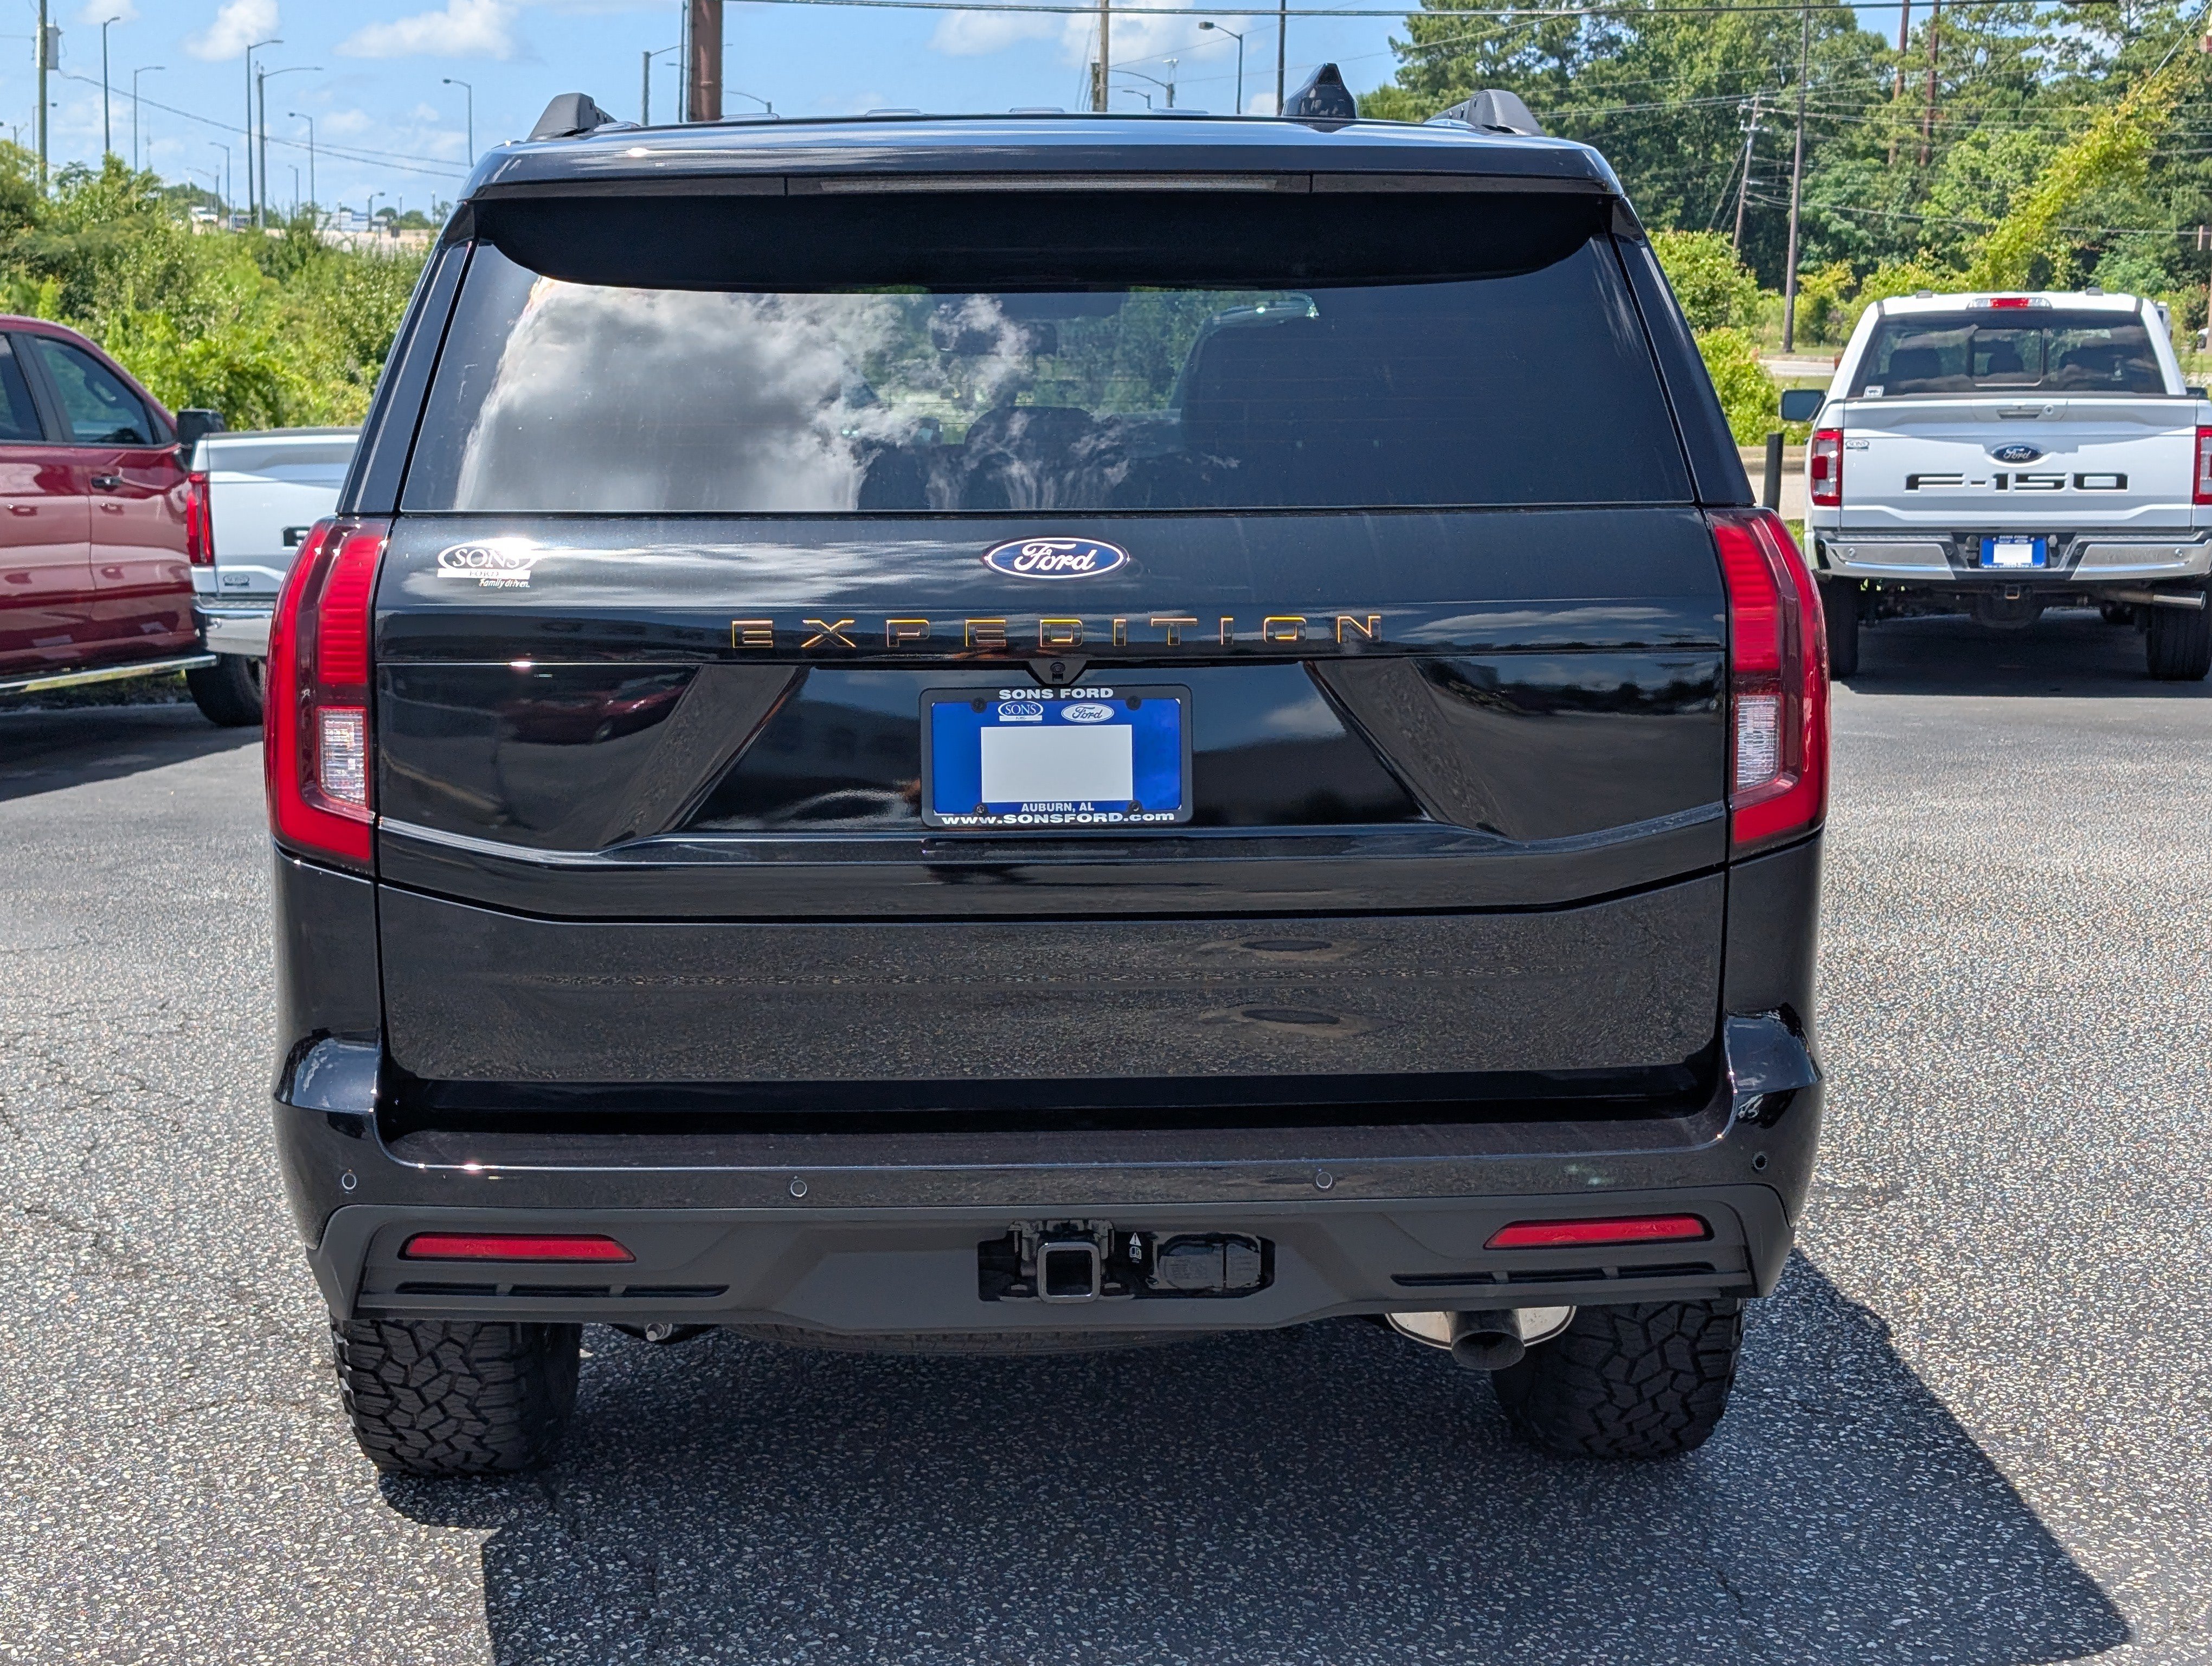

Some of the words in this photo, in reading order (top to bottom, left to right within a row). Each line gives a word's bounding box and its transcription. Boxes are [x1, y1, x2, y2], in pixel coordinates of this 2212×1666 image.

[2003, 447, 2032, 460] Ford
[1904, 472, 2129, 493] F-150
[452, 548, 520, 568] SONS
[1013, 542, 1098, 571] Ford
[731, 615, 1381, 649] EXPEDITION
[999, 689, 1053, 700] SONS
[1060, 688, 1114, 699] FORD
[1005, 704, 1037, 715] SONS
[1071, 706, 1103, 719] Ford
[1021, 803, 1076, 813] AUBURN,
[1080, 803, 1095, 811] AL
[942, 812, 1175, 824] www.SONSFORD.com
